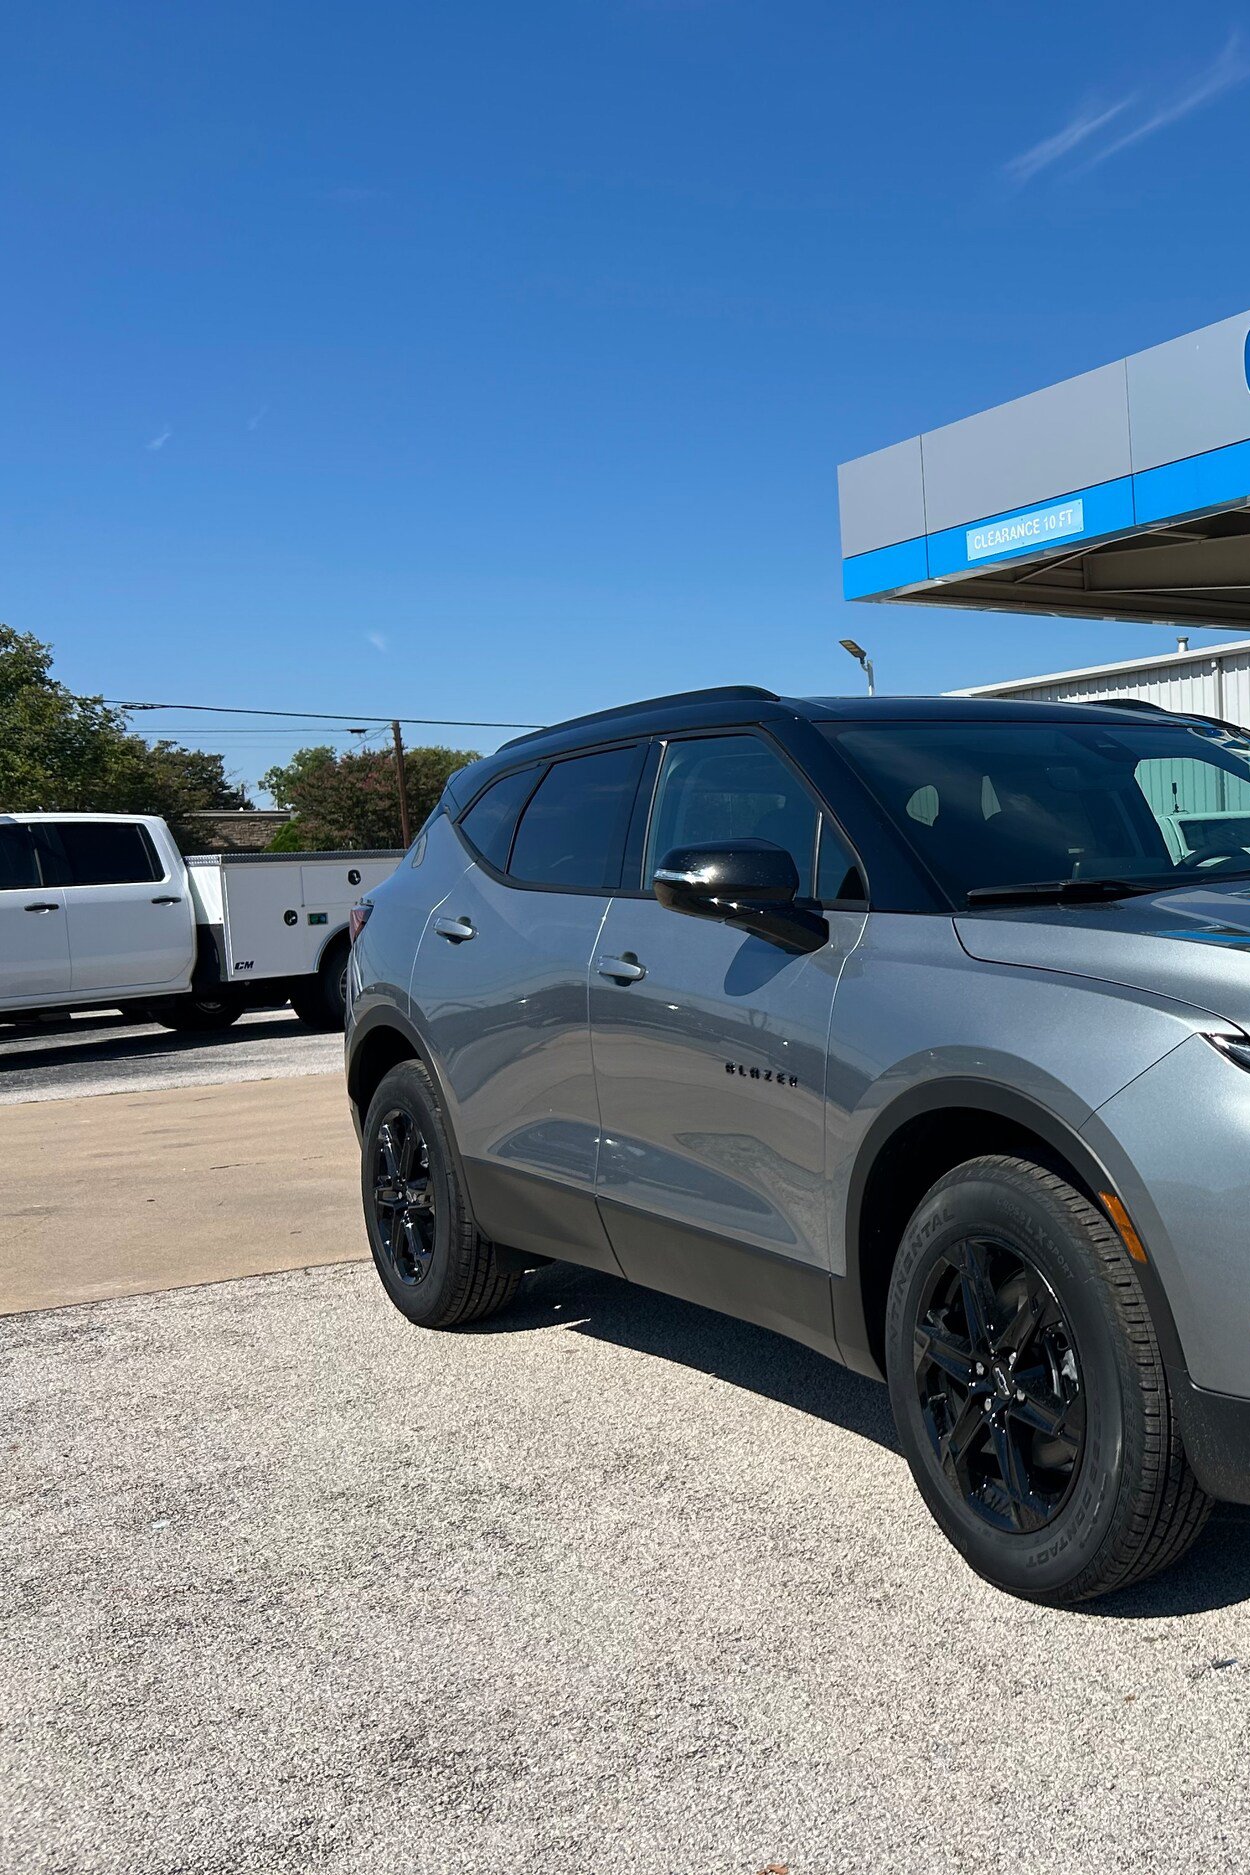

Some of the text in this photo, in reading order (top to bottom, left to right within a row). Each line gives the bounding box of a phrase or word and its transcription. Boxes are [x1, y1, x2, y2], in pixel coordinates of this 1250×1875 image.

[974, 509, 1074, 550] CLEARANCE 10 FT
[234, 961, 254, 970] CM
[725, 1062, 798, 1088] BLAZER
